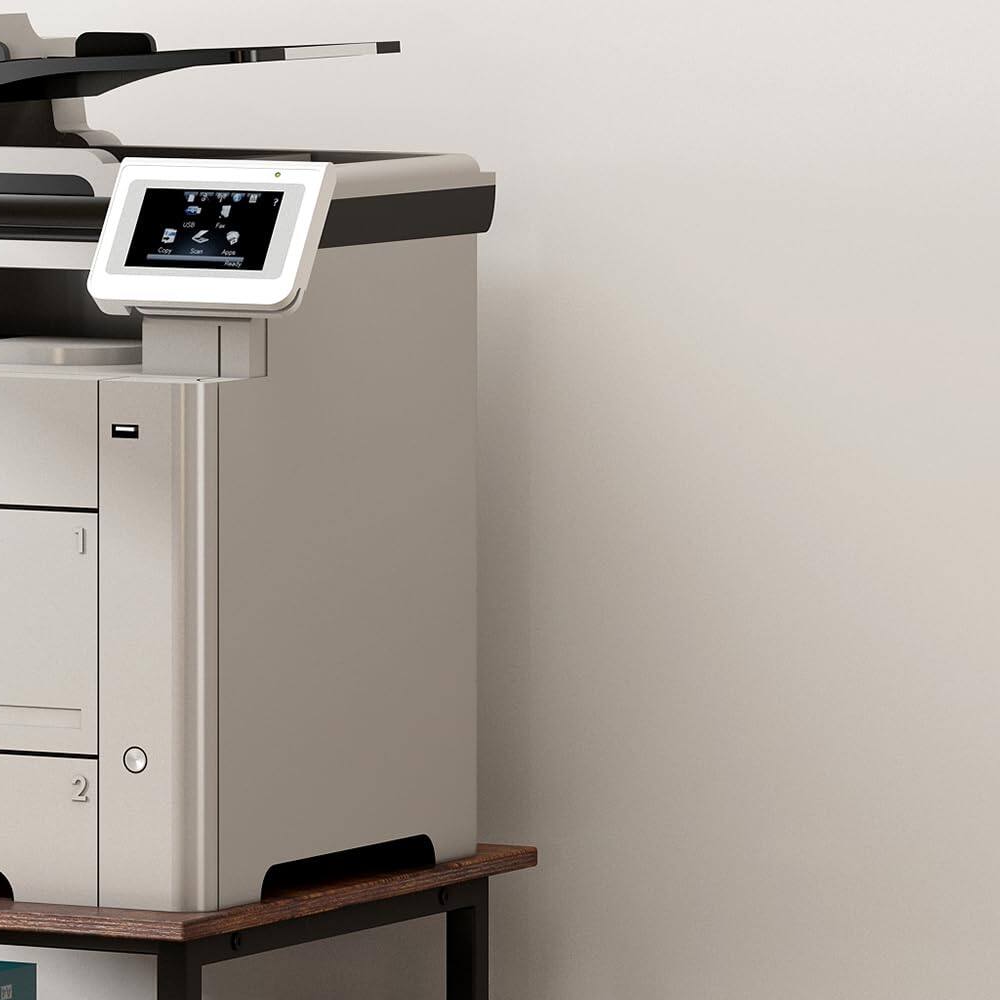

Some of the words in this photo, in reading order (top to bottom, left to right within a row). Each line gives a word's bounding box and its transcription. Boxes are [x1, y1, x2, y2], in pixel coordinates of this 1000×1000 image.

[182, 221, 196, 229] USB
[215, 222, 226, 230] Fax
[157, 246, 173, 256] Copy
[189, 247, 204, 255] Scan
[221, 248, 237, 257] Apps
[74, 526, 87, 555] 1
[71, 775, 89, 803] 2
